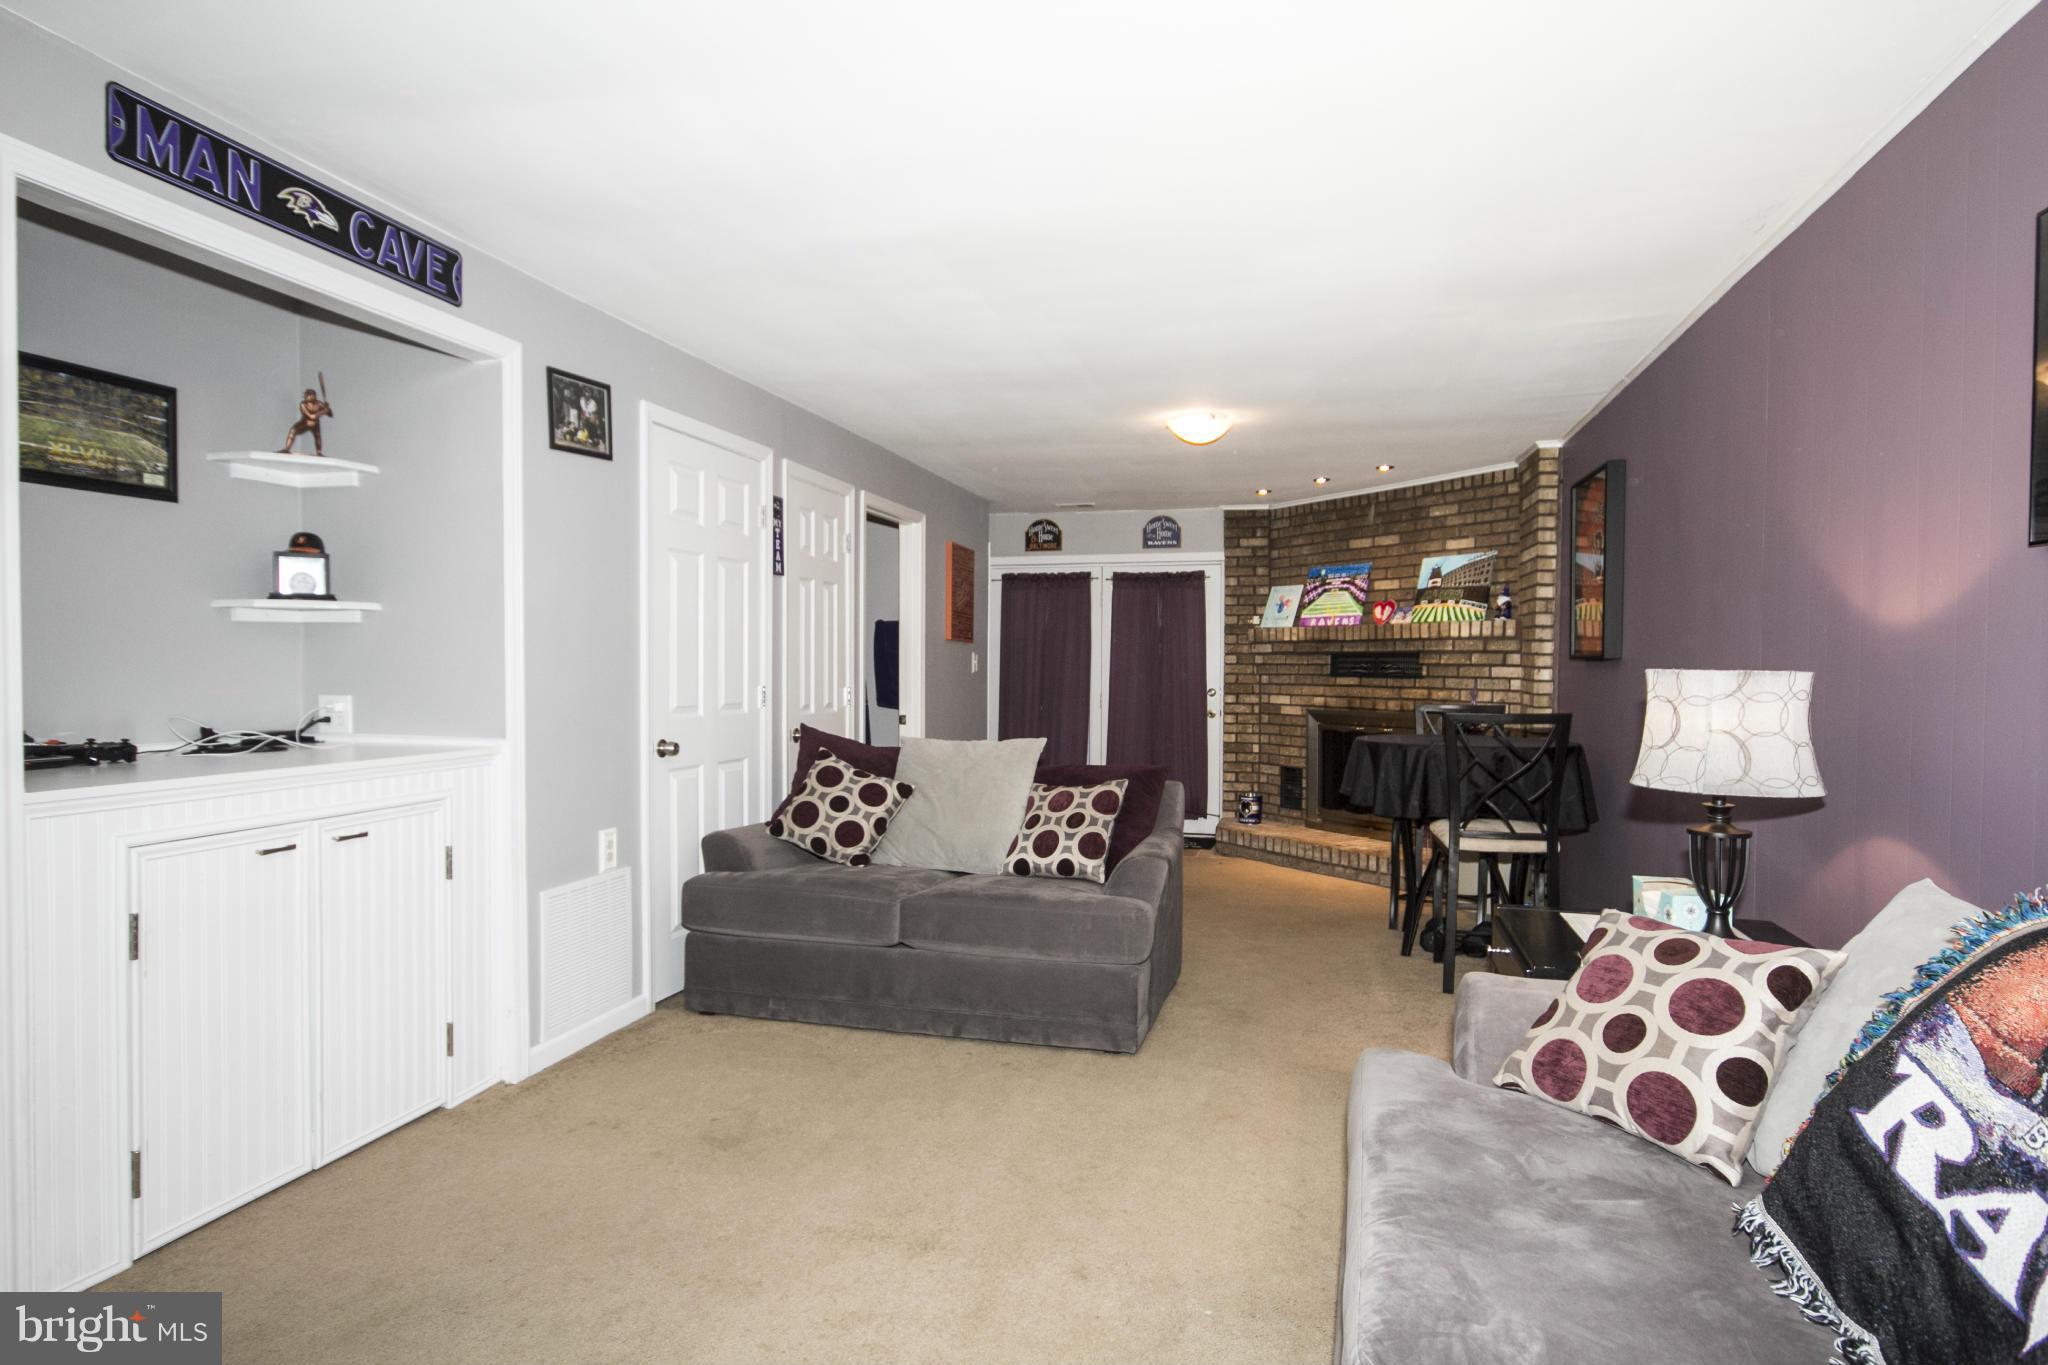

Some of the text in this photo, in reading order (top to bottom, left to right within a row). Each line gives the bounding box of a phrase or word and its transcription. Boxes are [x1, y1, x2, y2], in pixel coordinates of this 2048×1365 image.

[136, 104, 448, 295] MAN CAVE
[1310, 616, 1355, 626] RAVENS
[1850, 1054, 2048, 1356] RA
